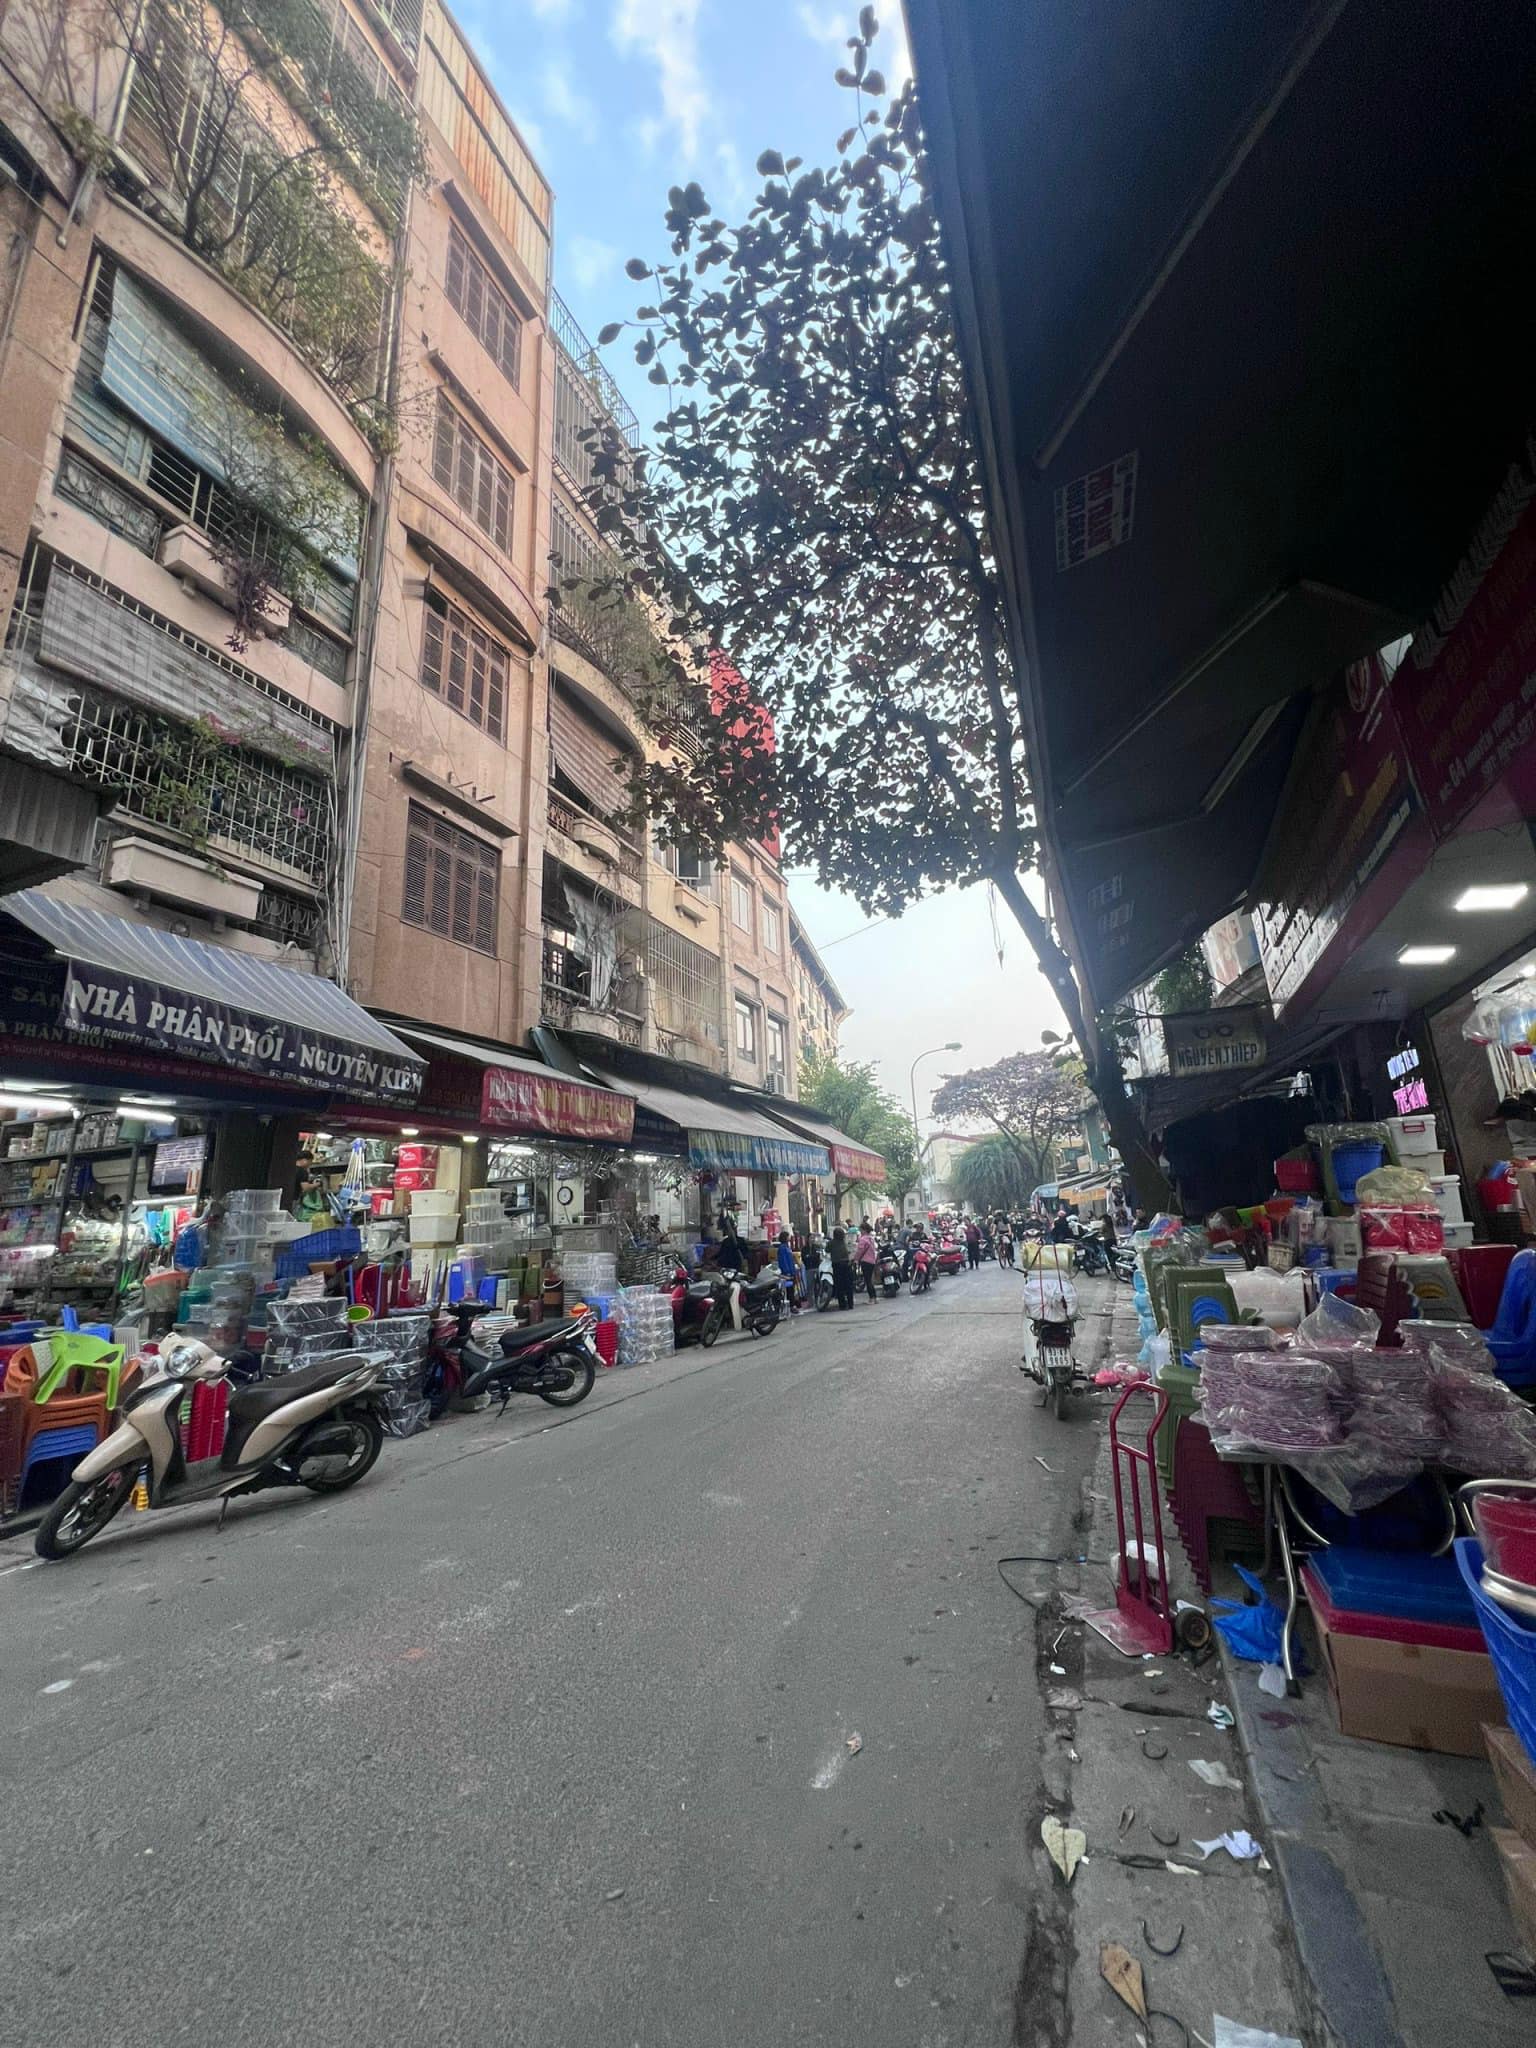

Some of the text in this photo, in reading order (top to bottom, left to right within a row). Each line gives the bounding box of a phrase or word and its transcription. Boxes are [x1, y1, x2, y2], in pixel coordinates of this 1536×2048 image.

[70, 980, 138, 1024] NHÀ
[146, 999, 224, 1046] PHÂN
[227, 1025, 285, 1062] PHỐI
